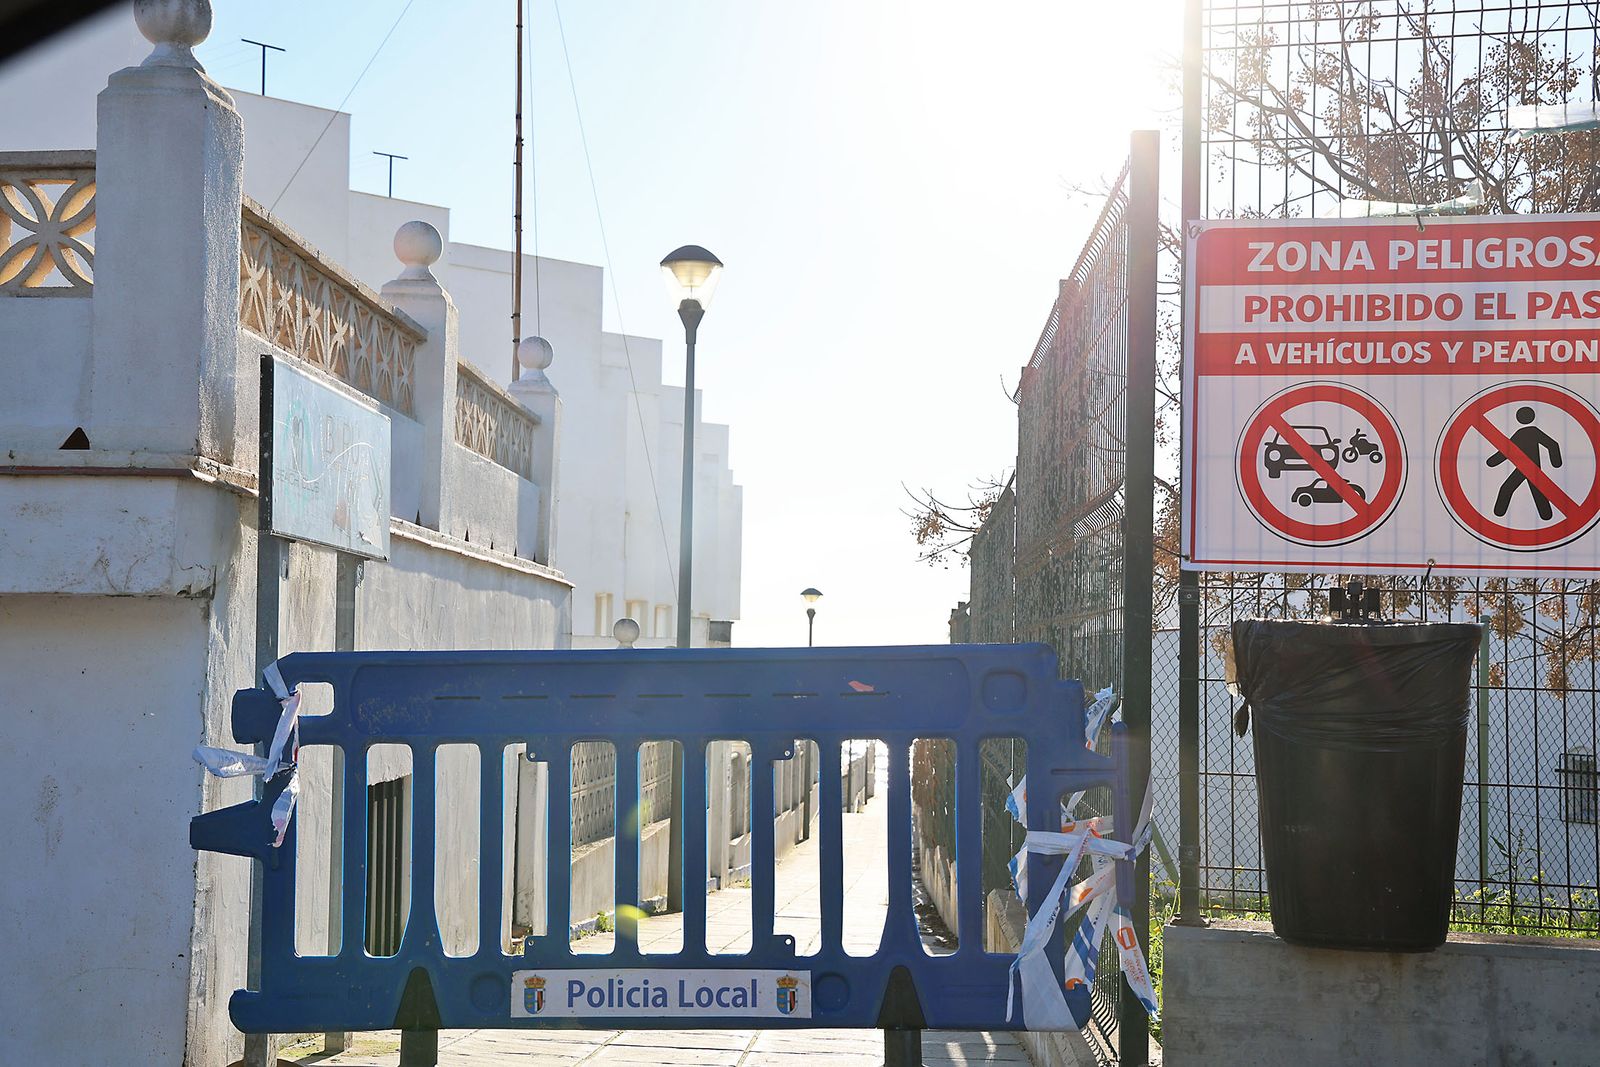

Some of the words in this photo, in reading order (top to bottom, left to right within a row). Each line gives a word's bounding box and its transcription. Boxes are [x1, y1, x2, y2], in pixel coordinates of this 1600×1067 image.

[1247, 240, 1375, 272] ZONA
[1388, 235, 1600, 271] PELIGROS
[1244, 293, 1463, 323] PROHIBIDO
[1475, 292, 1516, 321] EL
[1527, 290, 1600, 320] PAS
[1234, 342, 1257, 365] A
[1266, 337, 1431, 364] VEHÍCULOS
[1440, 340, 1463, 364] Y
[1473, 339, 1598, 363] PEATON
[567, 979, 668, 1008] Policia
[679, 979, 758, 1008] Local
